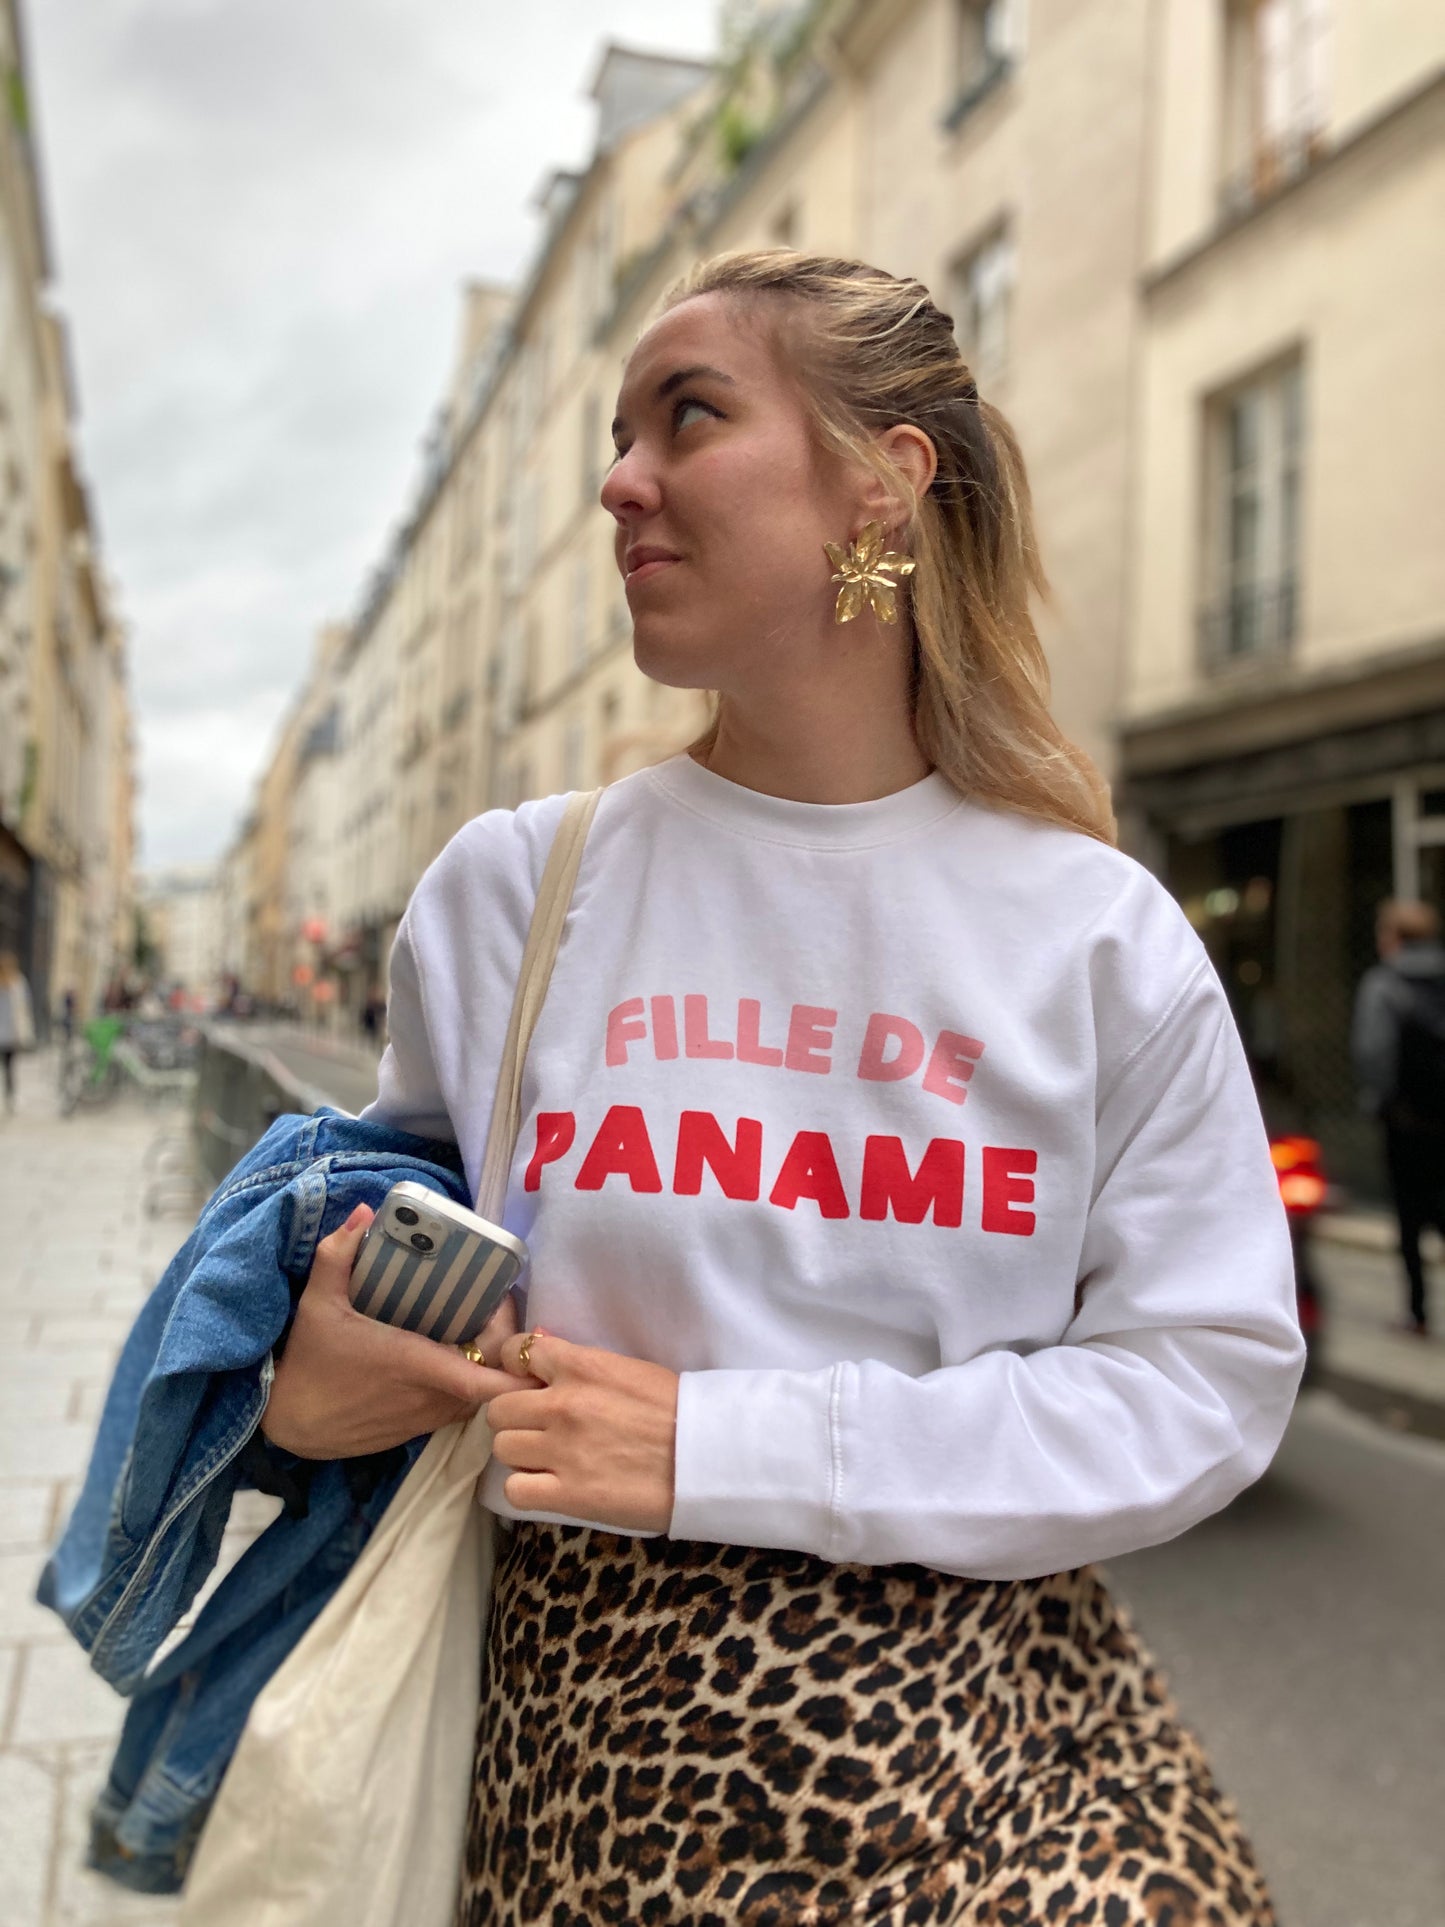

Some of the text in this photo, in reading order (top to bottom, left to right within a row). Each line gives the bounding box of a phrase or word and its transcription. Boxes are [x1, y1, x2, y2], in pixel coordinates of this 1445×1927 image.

[606, 994, 984, 1104] FILLE DE
[524, 1104, 1039, 1238] PANAME
